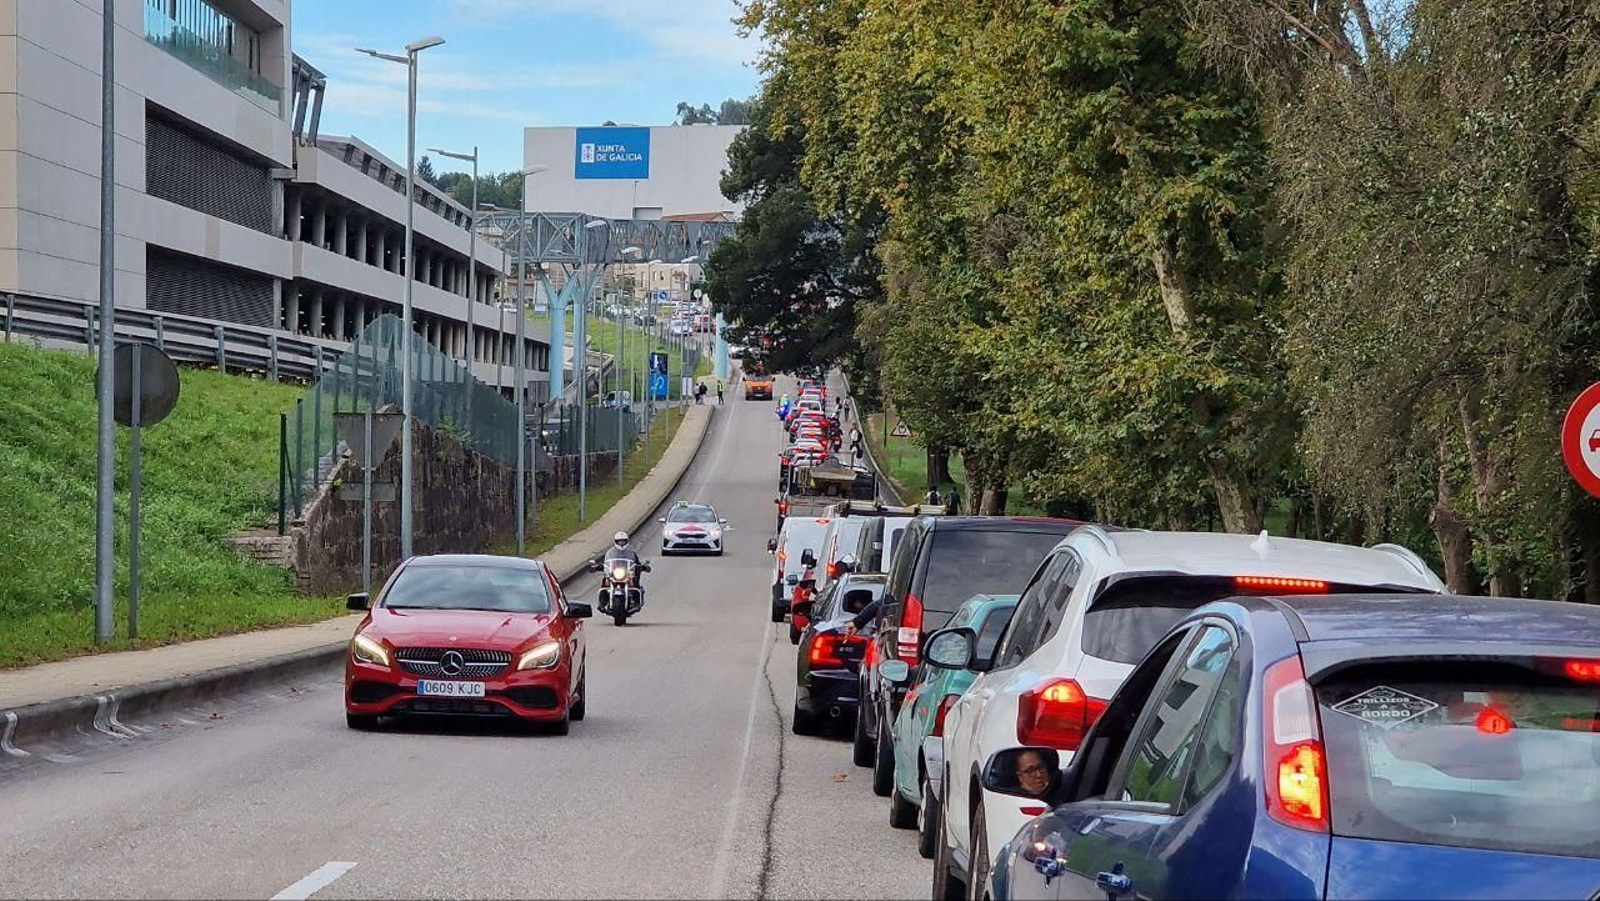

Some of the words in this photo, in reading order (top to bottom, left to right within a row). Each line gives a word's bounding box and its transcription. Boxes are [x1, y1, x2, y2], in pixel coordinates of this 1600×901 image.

[597, 144, 626, 153] XUNTA
[596, 153, 607, 161] DE
[609, 153, 643, 161] GALICIA
[425, 682, 453, 694] 0609
[458, 683, 481, 695] KJC
[1361, 710, 1411, 718] BORDO
